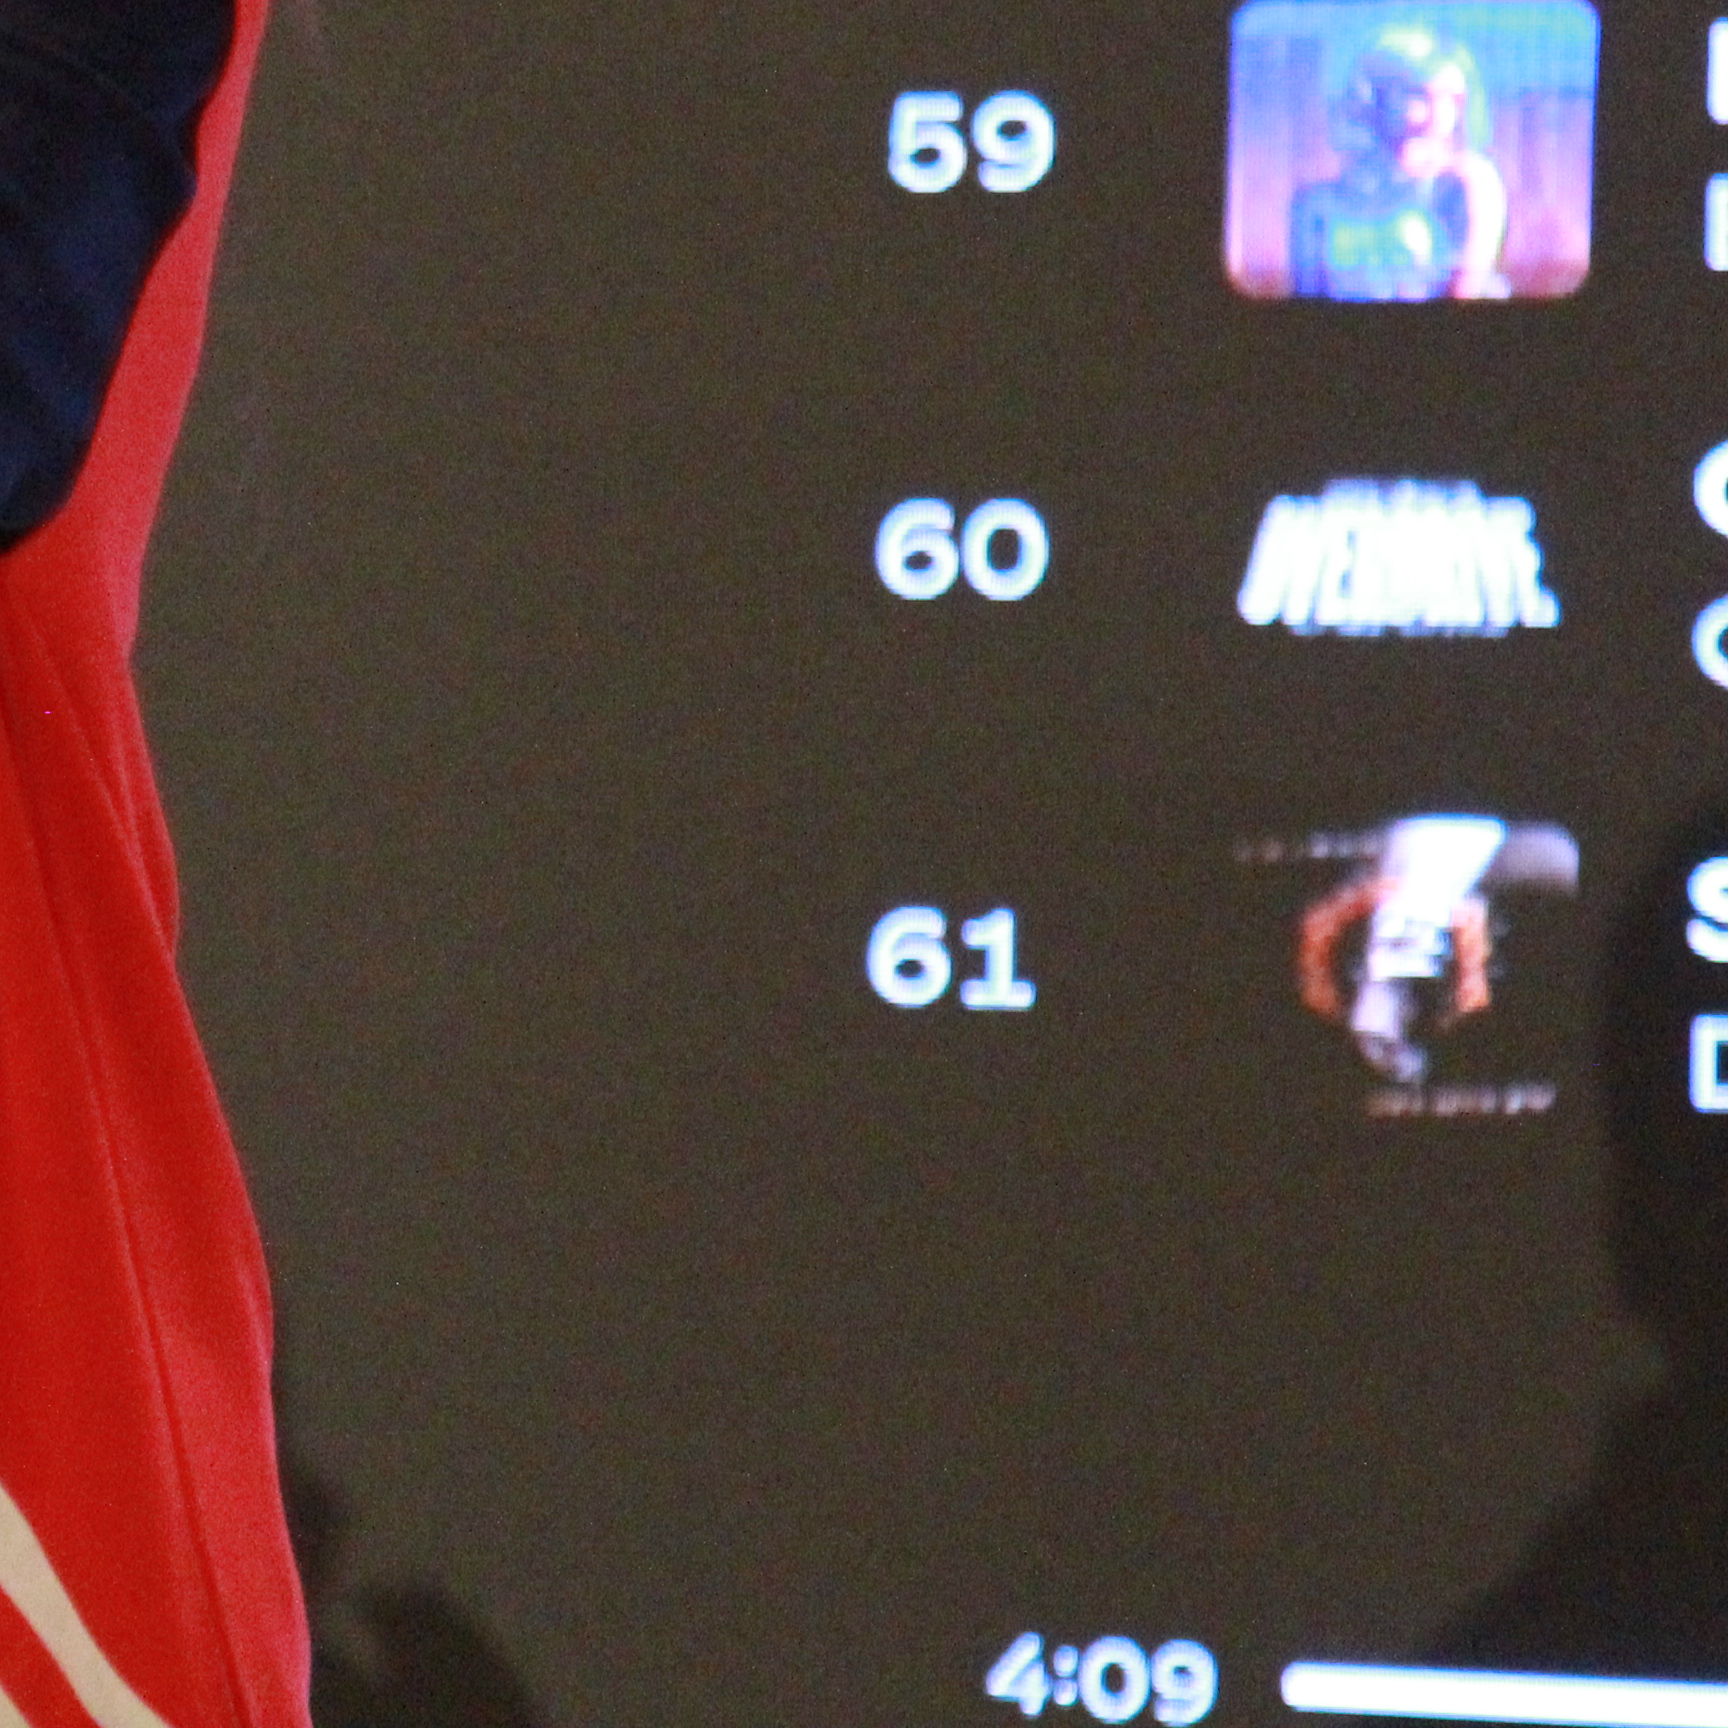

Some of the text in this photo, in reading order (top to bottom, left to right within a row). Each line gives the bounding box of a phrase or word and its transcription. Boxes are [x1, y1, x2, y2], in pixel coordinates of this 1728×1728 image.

[887, 90, 1055, 193] 59
[875, 497, 1050, 602] 60
[866, 906, 1036, 1011] 61
[986, 1632, 1218, 1727] 4:09
